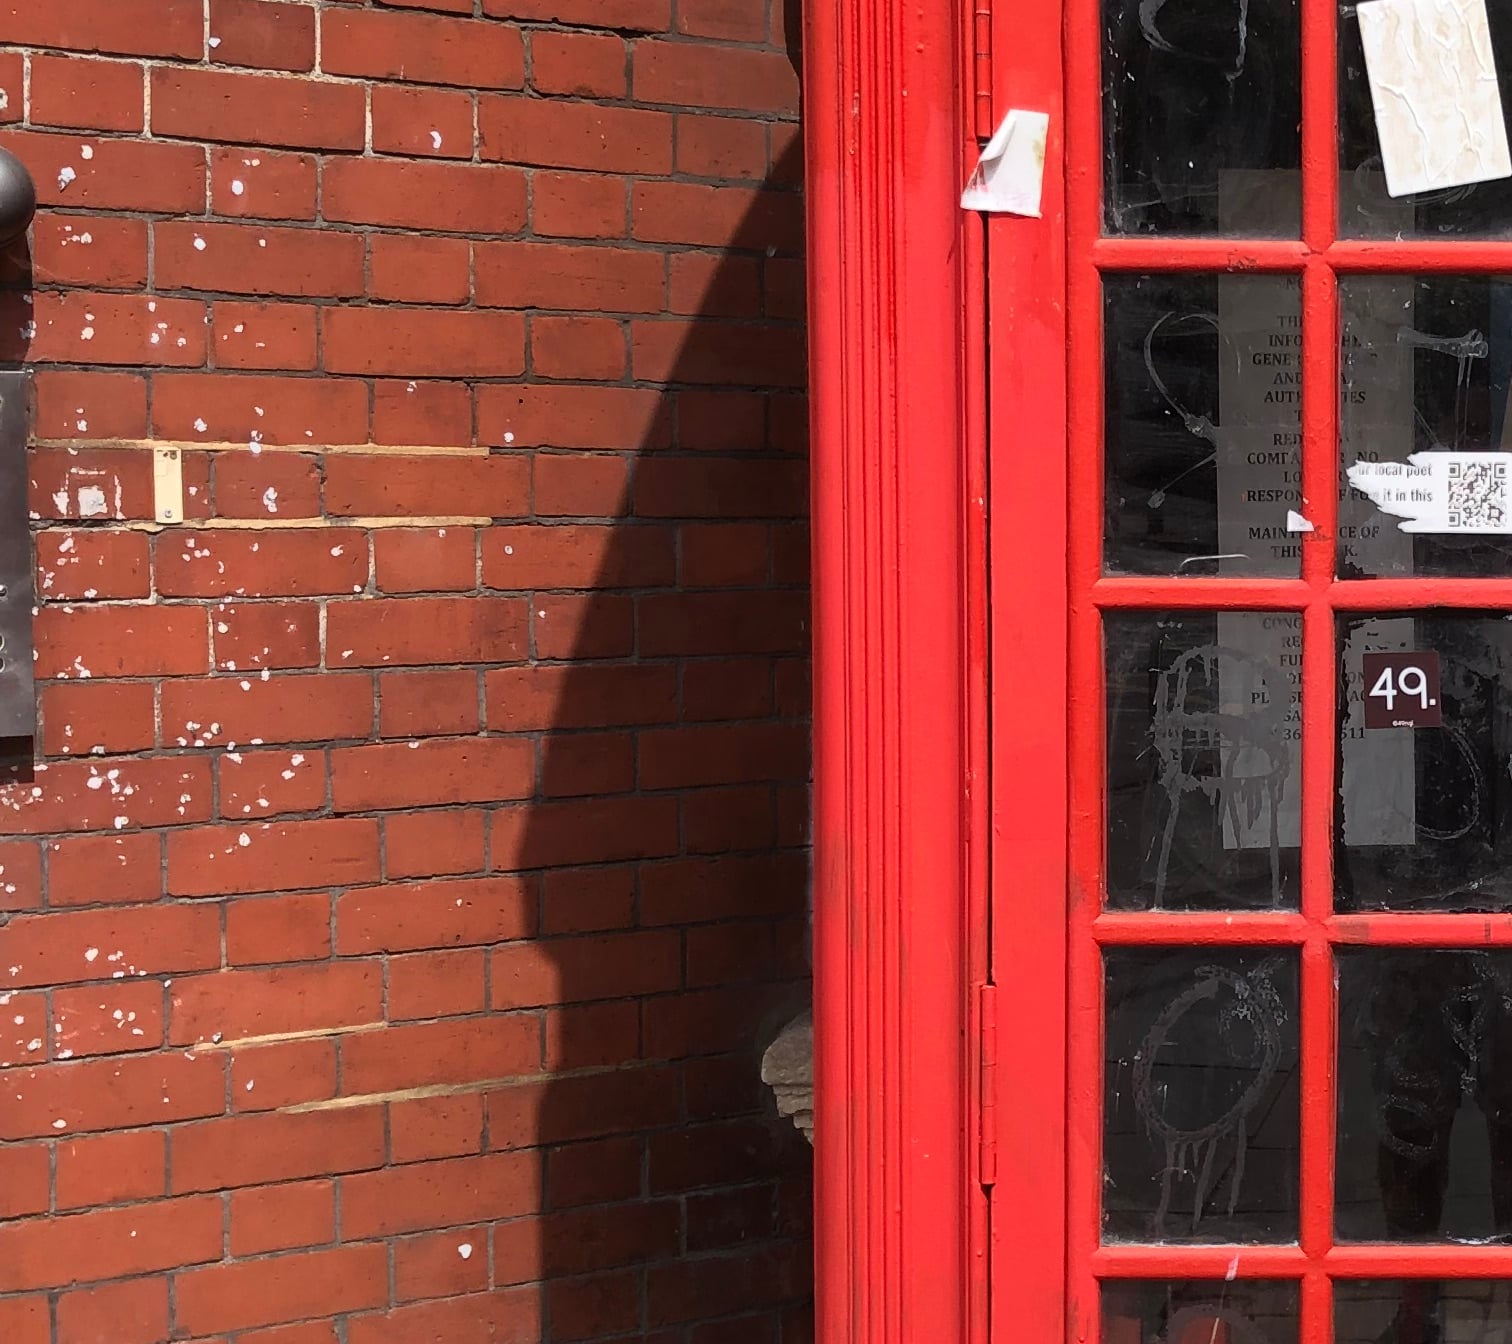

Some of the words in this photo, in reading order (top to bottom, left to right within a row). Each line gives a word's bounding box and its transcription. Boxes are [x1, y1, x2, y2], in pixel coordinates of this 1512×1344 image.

[1407, 464, 1432, 477] poet
[1396, 492, 1406, 501] in
[1410, 491, 1432, 501] this
[1369, 666, 1437, 710] 49.
